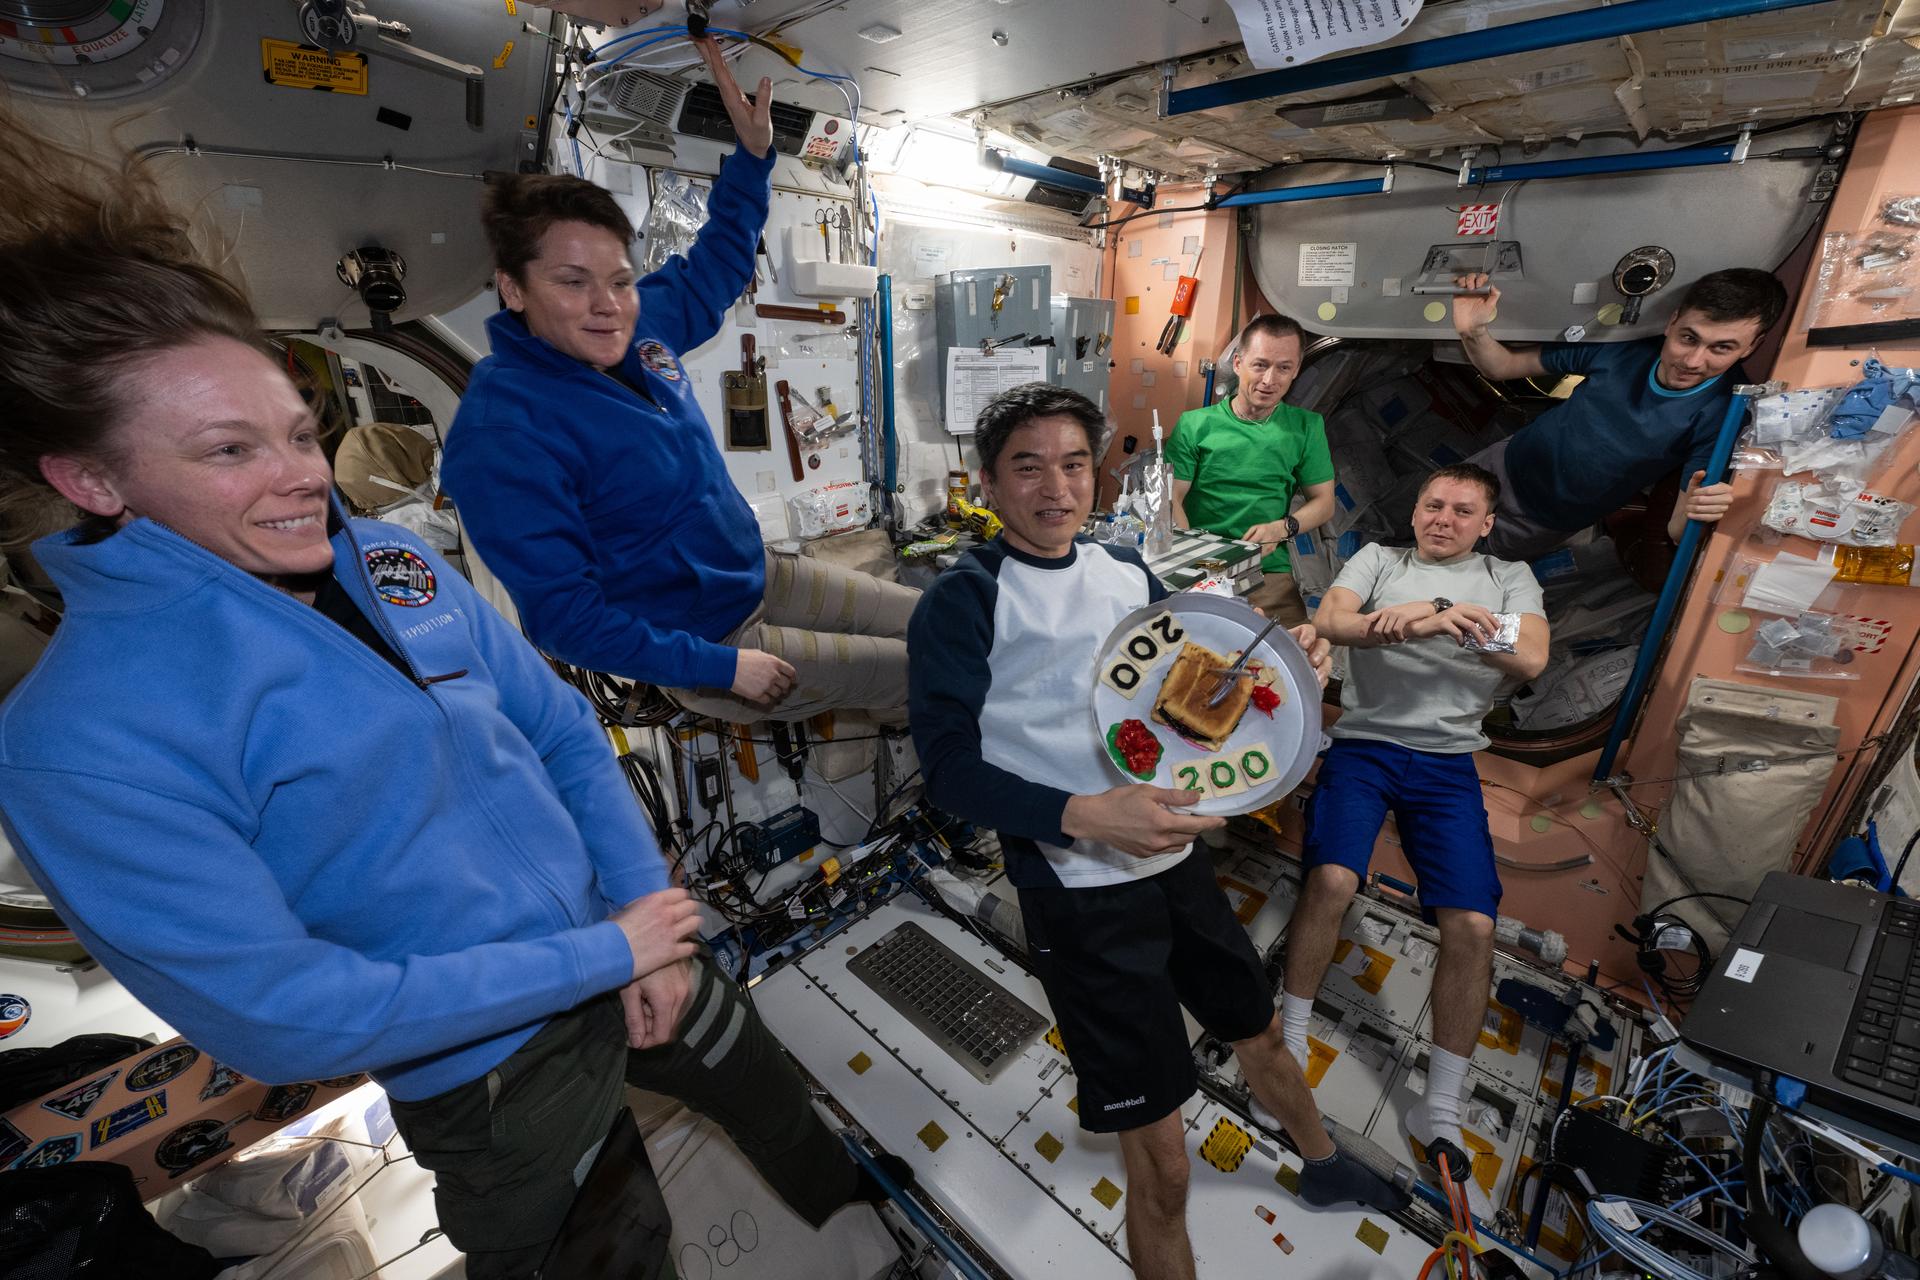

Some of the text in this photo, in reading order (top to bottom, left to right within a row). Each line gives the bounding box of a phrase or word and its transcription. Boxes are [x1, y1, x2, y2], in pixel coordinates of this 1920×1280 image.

[1278, 11, 1286, 28] from
[1290, 7, 1302, 34] stowage
[73, 29, 130, 54] EQUALIZE
[1268, 26, 1280, 53] GATHER
[1282, 30, 1292, 50] below
[291, 52, 342, 66] WARNING
[1464, 212, 1492, 228] EXIT
[1857, 632, 1878, 640] ORT
[1110, 616, 1184, 690] 200
[1178, 750, 1270, 794] 200
[64, 1089, 100, 1110] 46
